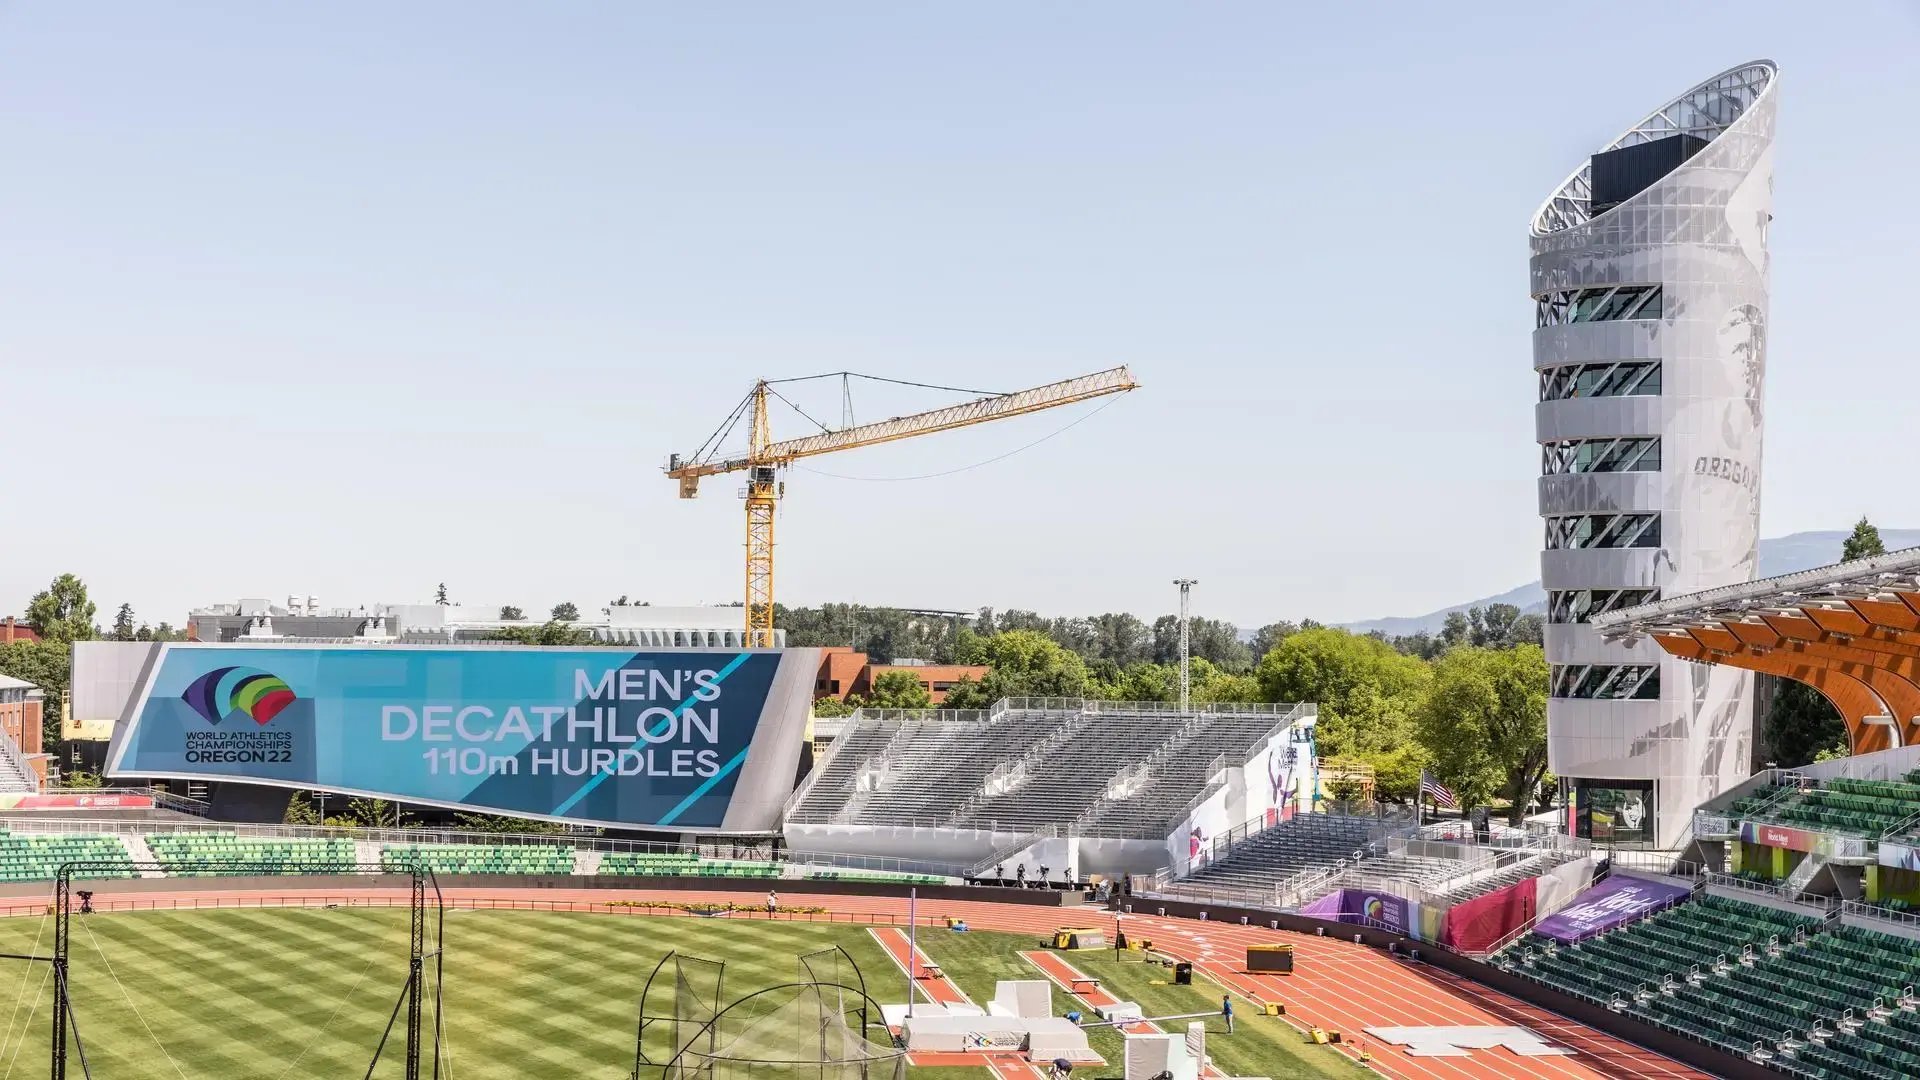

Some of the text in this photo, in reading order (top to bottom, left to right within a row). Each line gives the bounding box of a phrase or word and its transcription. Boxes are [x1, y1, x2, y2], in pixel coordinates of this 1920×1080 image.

[574, 668, 721, 702] MEN’S
[186, 731, 292, 740] WORLD ATHLETICS
[382, 705, 719, 744] DECATHLON
[186, 740, 292, 749] CHAMPIONSHIPS
[423, 748, 720, 777] 110m HURDLES
